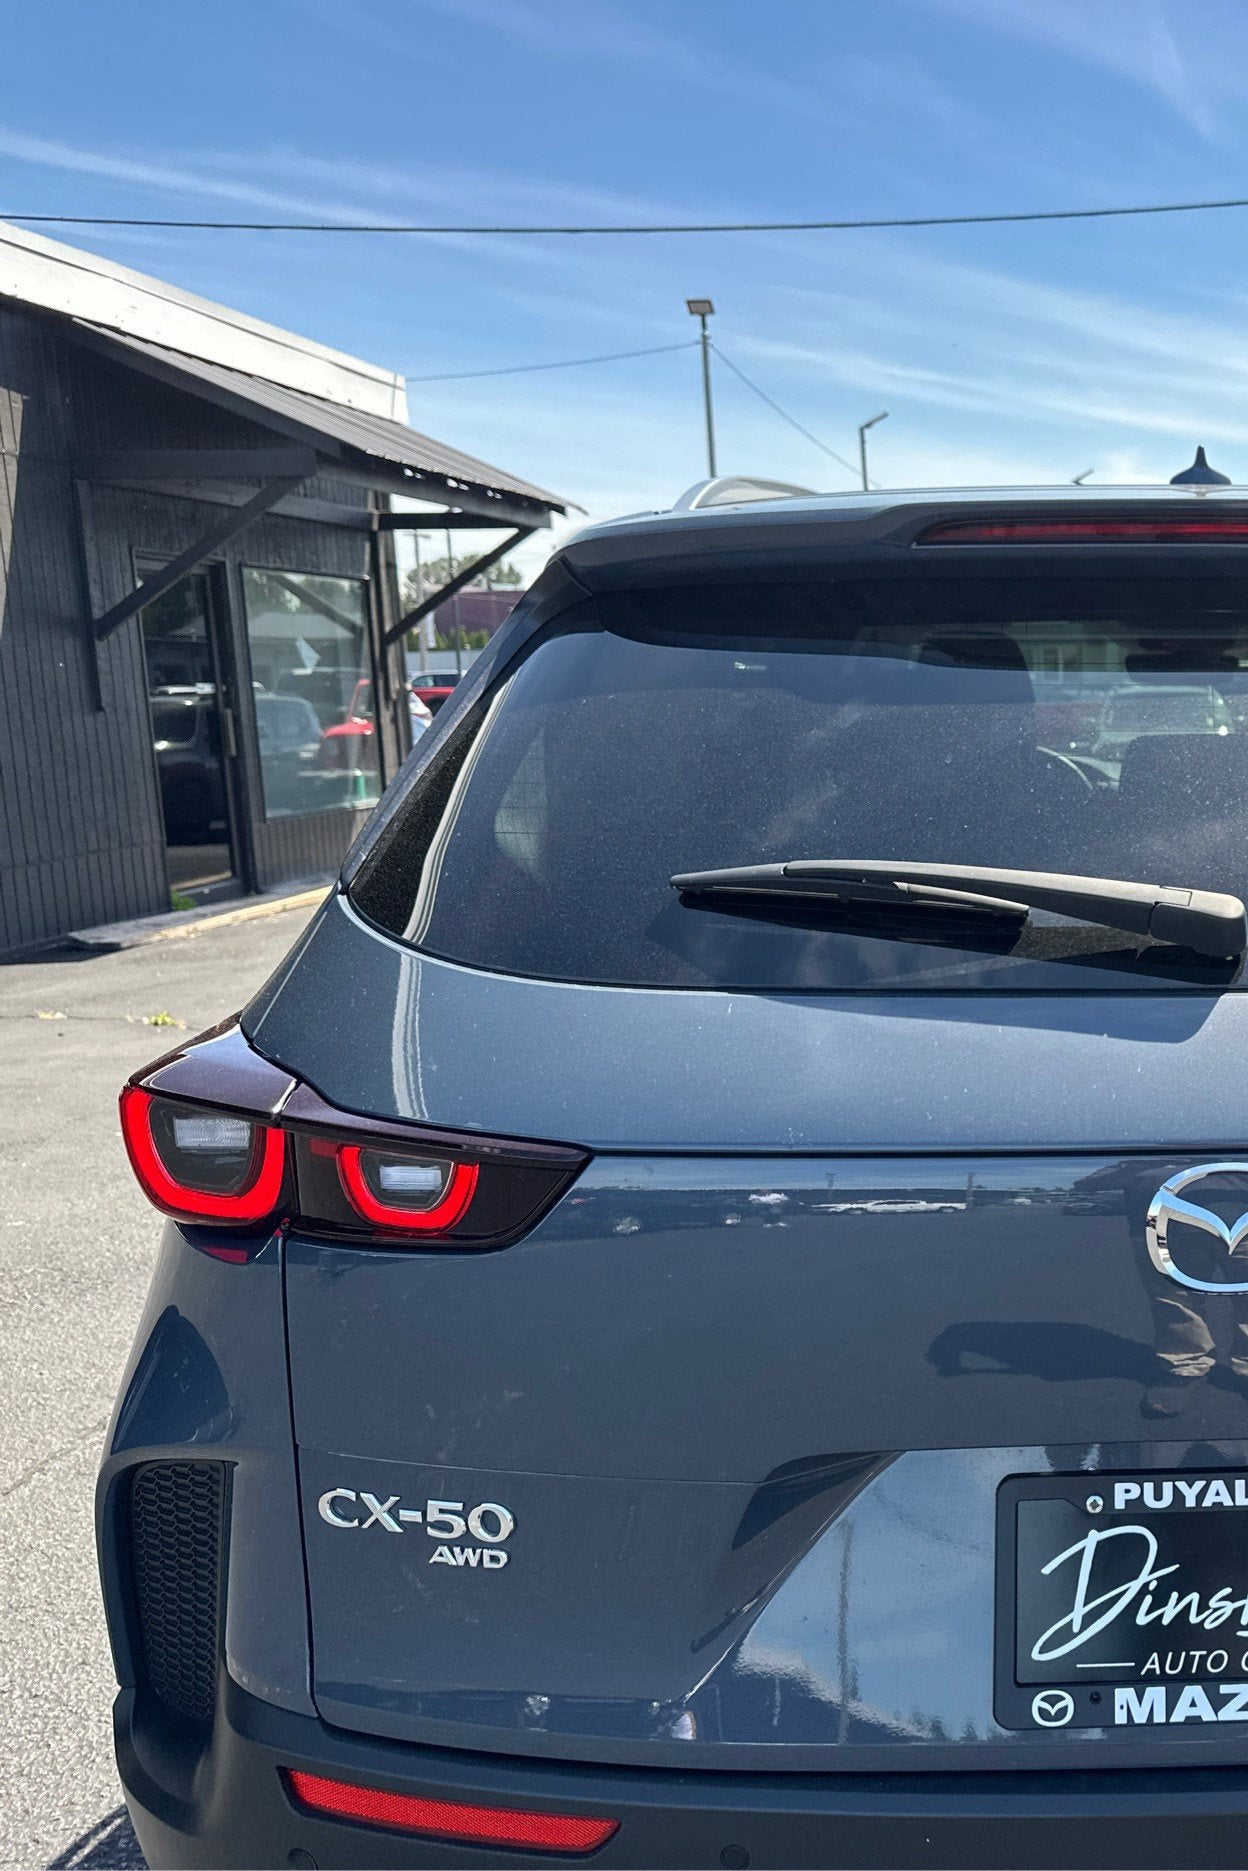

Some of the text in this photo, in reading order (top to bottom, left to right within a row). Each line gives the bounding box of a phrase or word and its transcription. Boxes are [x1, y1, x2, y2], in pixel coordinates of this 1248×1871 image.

[317, 1487, 515, 1544] CX-50
[428, 1545, 508, 1570] AWD
[1140, 1648, 1227, 1675] AUTO
